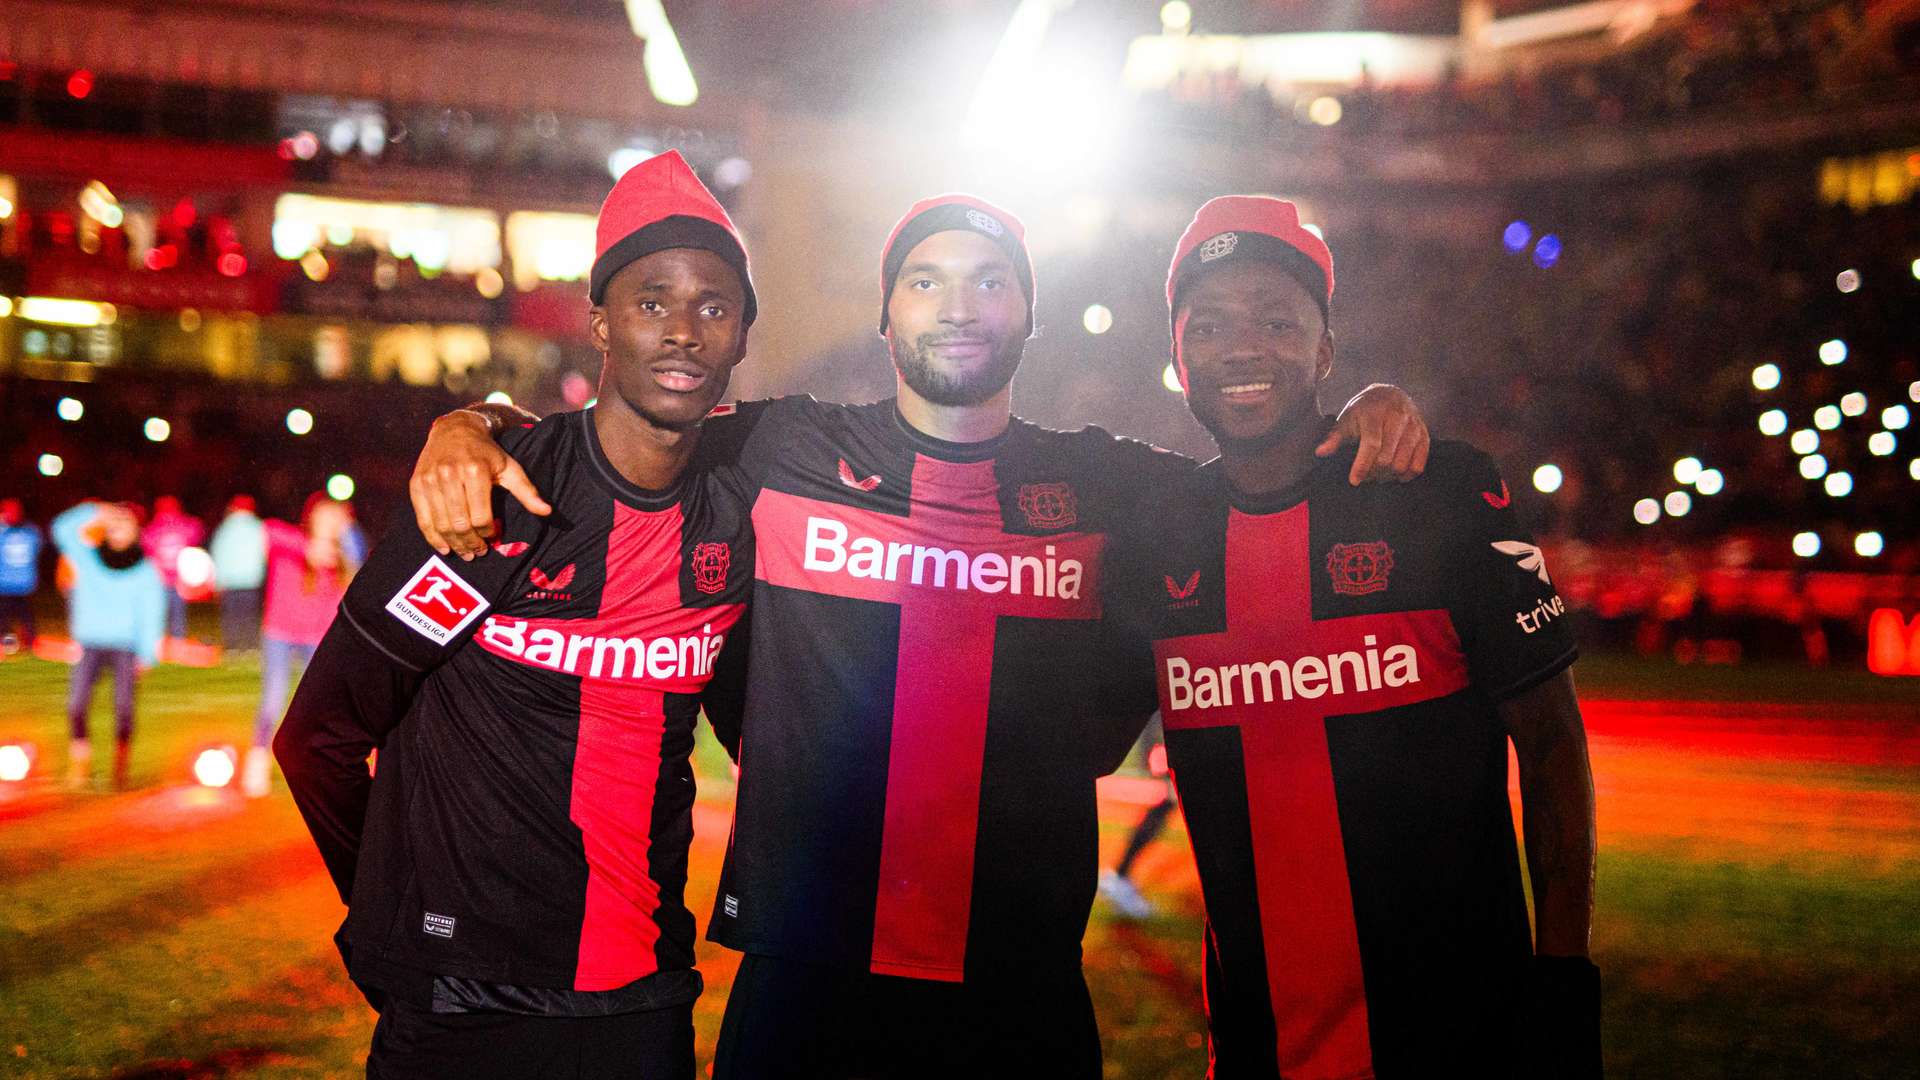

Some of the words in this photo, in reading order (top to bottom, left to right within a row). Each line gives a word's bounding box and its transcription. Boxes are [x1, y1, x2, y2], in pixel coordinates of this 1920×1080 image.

[804, 516, 1083, 600] Barmenia
[395, 601, 446, 639] BUNDESLIGA
[1516, 595, 1565, 634] trive
[1166, 635, 1420, 710] Barmenia
